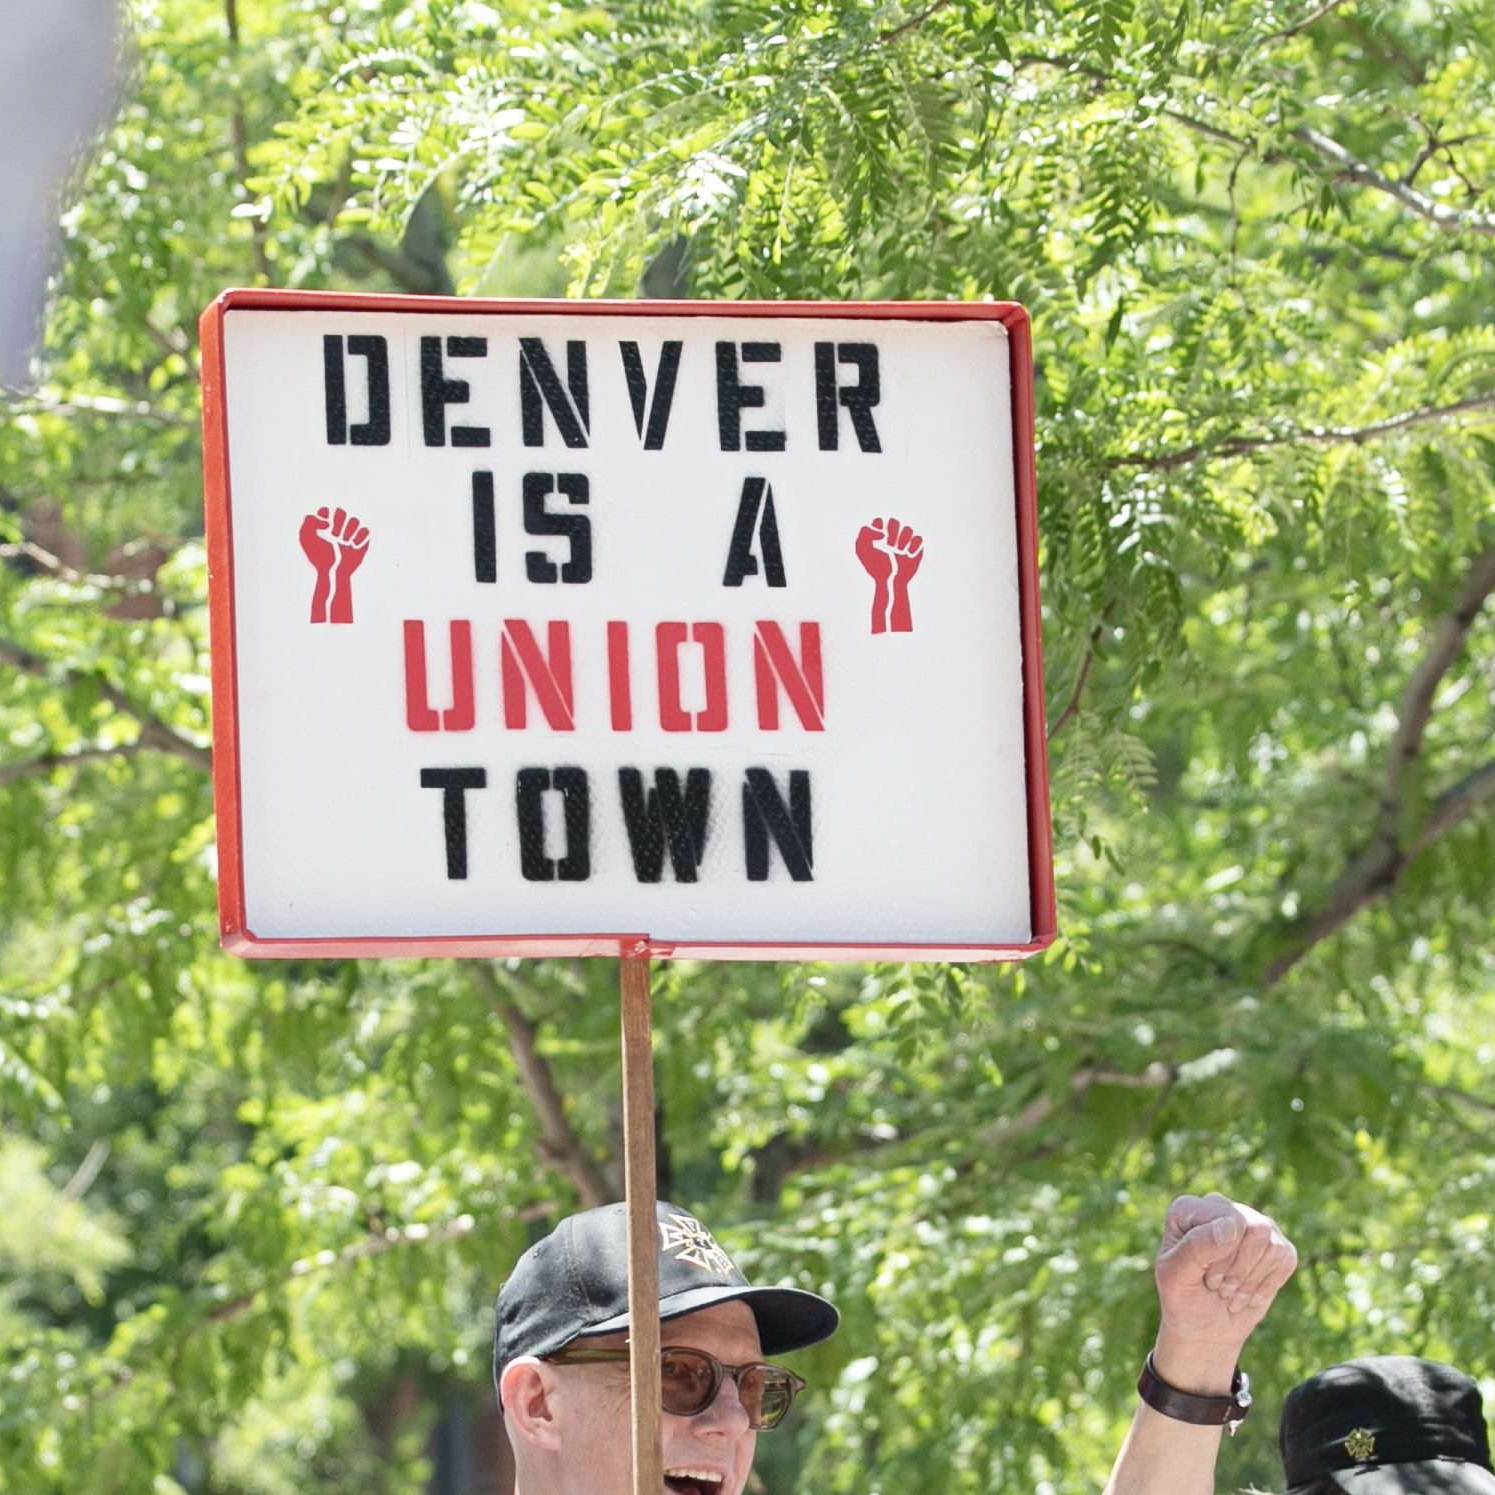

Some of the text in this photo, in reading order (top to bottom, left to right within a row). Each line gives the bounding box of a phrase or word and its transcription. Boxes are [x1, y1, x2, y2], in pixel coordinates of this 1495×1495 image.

[323, 334, 883, 453] DENVER
[471, 470, 788, 588] IS A
[402, 619, 826, 733] UNION
[419, 767, 815, 883] TOWN
